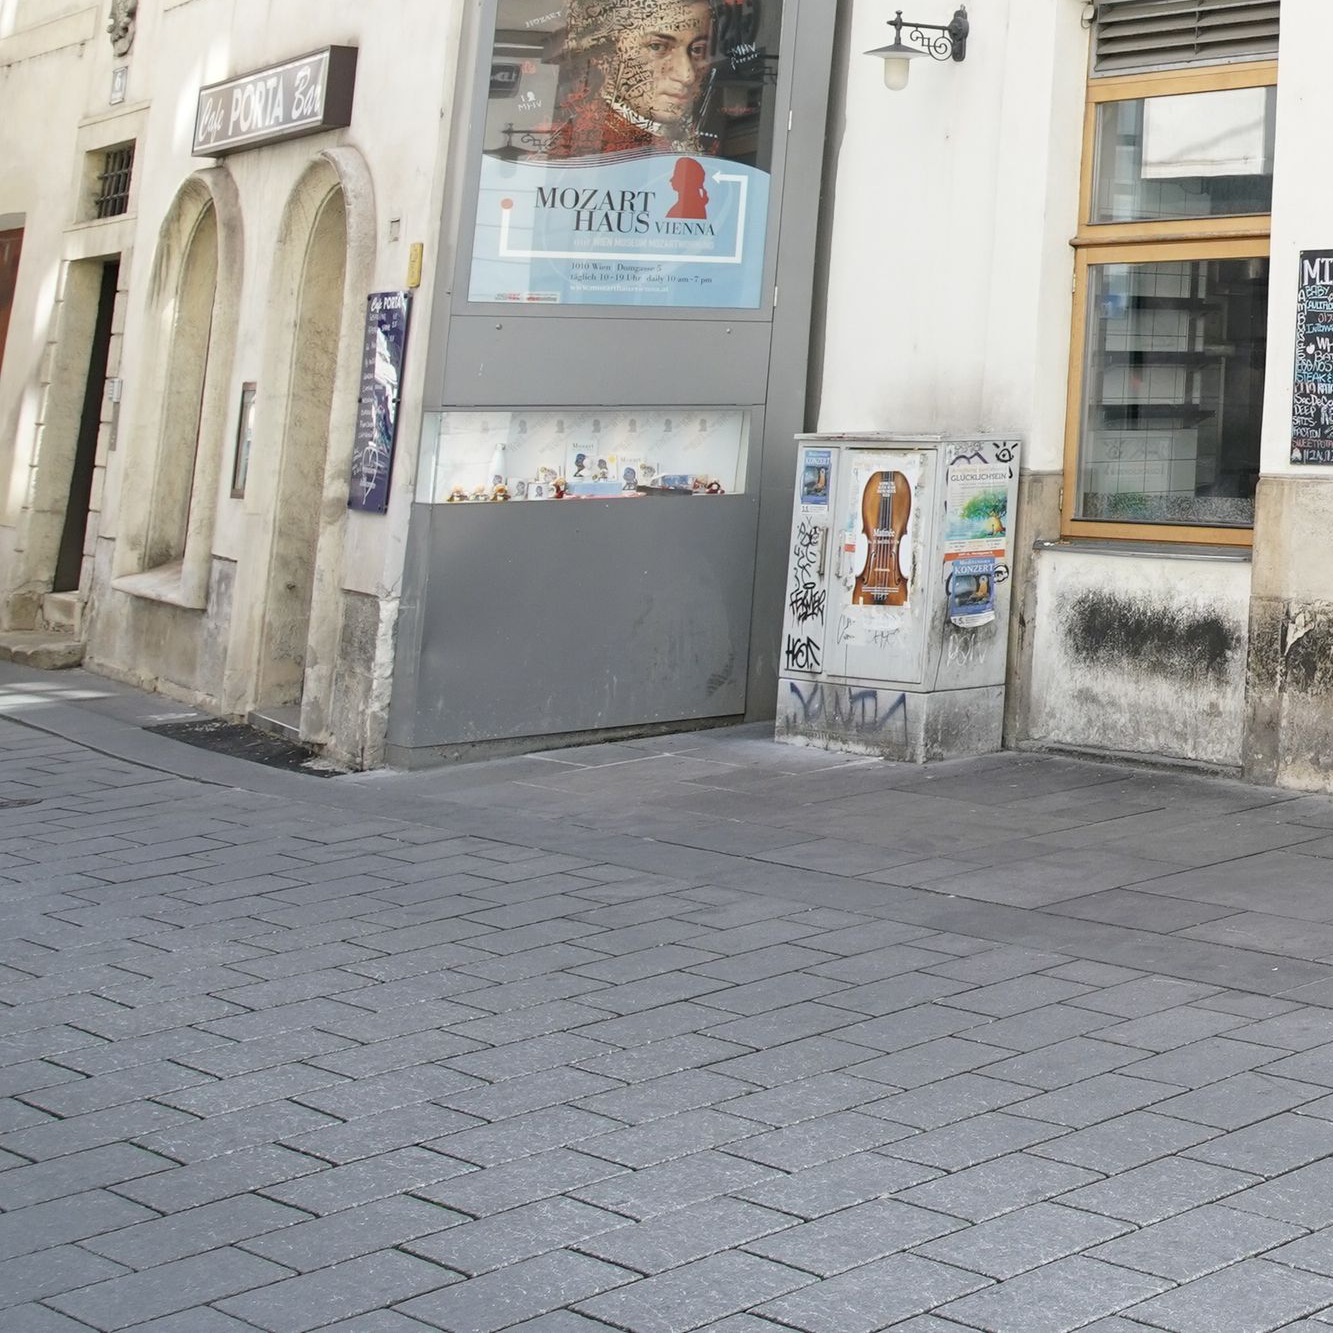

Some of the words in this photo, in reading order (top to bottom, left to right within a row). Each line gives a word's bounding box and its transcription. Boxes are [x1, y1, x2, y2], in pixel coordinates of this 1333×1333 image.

[198, 97, 225, 144] Cafe
[228, 74, 284, 136] PORTA
[291, 66, 323, 121] Bar
[535, 186, 656, 213] MOZART
[572, 210, 650, 233] HAUS
[654, 221, 716, 237] VIENNA
[571, 262, 590, 270] 1010
[592, 262, 611, 271] Wien
[617, 263, 655, 274] Domgasse
[646, 274, 664, 284] daily
[383, 296, 402, 310] PORTA
[805, 456, 832, 466] KONZERT
[950, 472, 1008, 482] GLÜCKLICHSEIN
[954, 565, 995, 575] KONZERT
